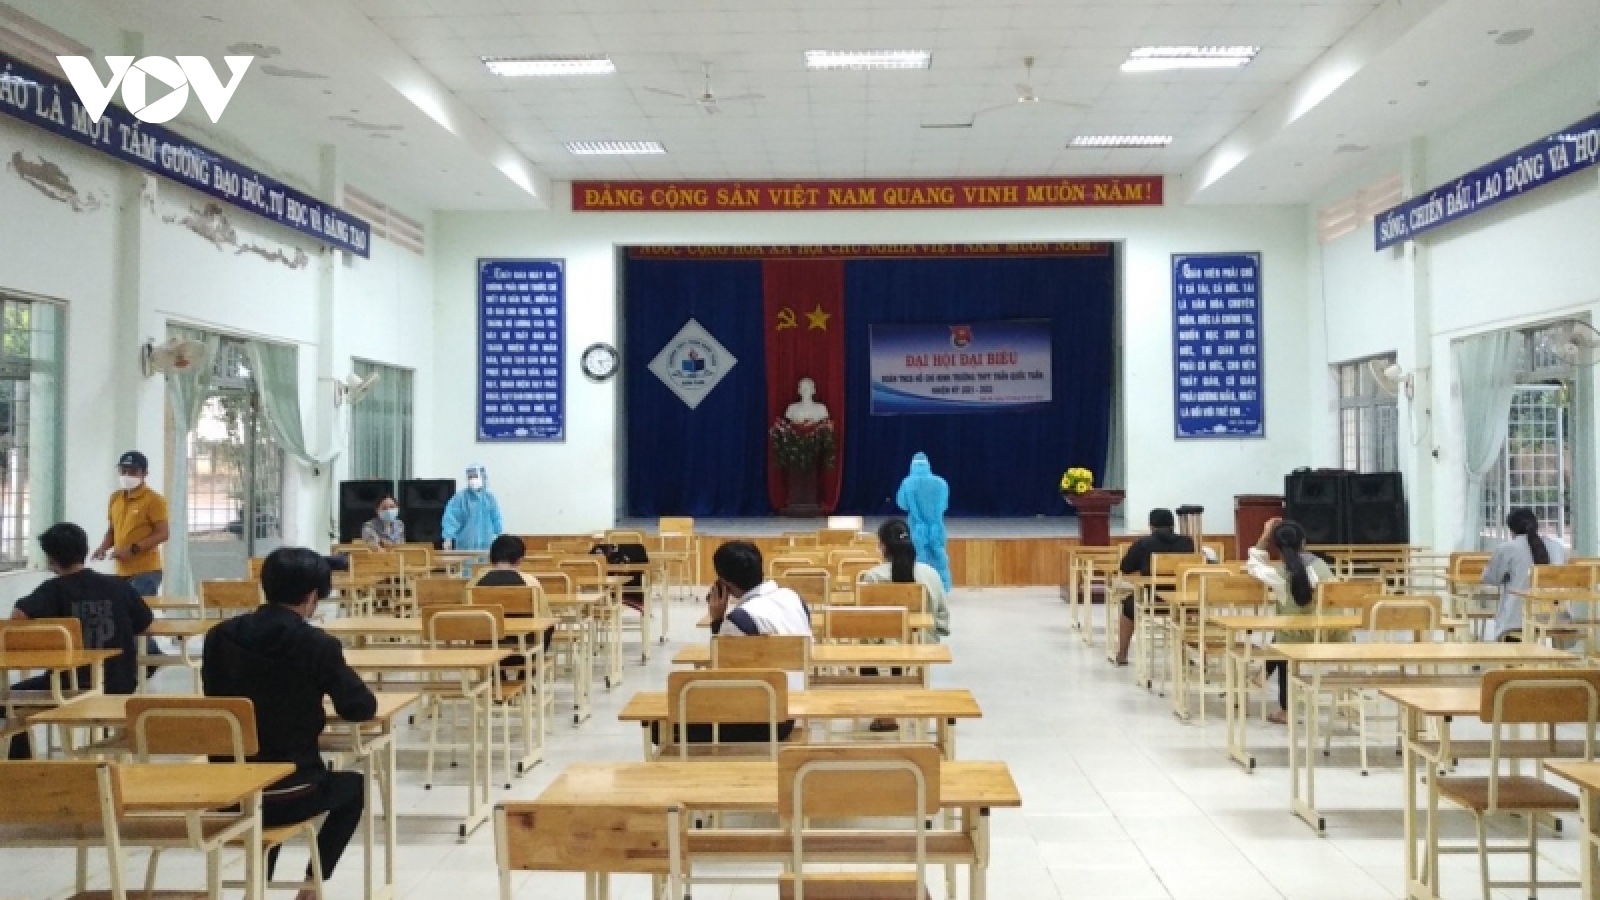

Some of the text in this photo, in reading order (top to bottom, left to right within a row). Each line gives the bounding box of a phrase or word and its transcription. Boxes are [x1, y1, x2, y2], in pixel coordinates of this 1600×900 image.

[35, 84, 65, 125] LÀ
[214, 165, 239, 198] ĐẠO
[287, 198, 308, 227] HỌC
[324, 212, 348, 242] SÁNG
[585, 182, 644, 206] ĐẢNG
[651, 184, 708, 209] CỘNG
[716, 182, 760, 206] SẢN
[768, 182, 820, 209] VIỆT
[828, 188, 877, 205] NAM
[883, 187, 955, 205] QUANG
[962, 185, 1018, 203] VINH
[1026, 180, 1086, 202] MUÔN
[1380, 211, 1408, 242] SỐNG,
[1410, 192, 1444, 230] CHIẾN
[1476, 172, 1502, 204] LAO
[1505, 153, 1544, 193] ĐỘNG
[906, 345, 1018, 370] ĐẠI HỘI ĐẠI BIỂU
